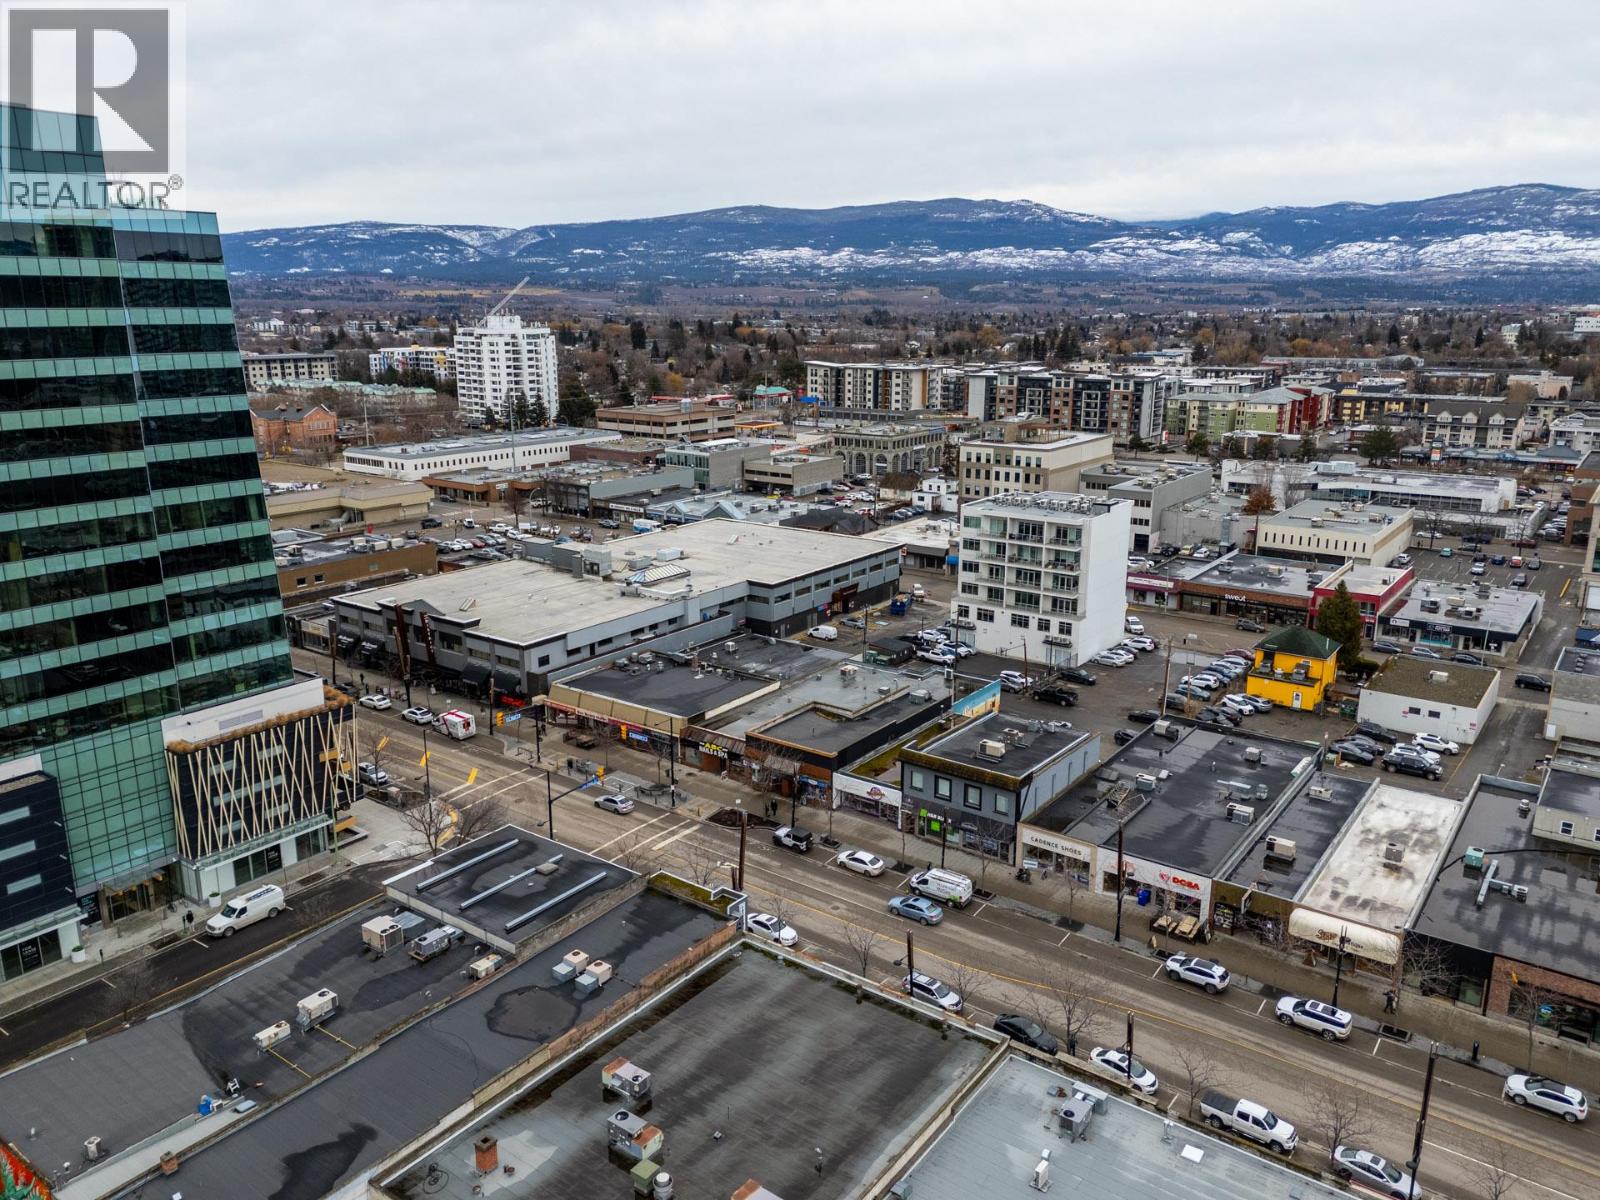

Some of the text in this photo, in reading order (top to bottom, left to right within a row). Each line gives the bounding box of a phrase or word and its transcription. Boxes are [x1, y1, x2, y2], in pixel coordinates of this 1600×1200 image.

[704, 742, 722, 751] ABC
[1031, 836, 1083, 856] CADENCE SHOES
